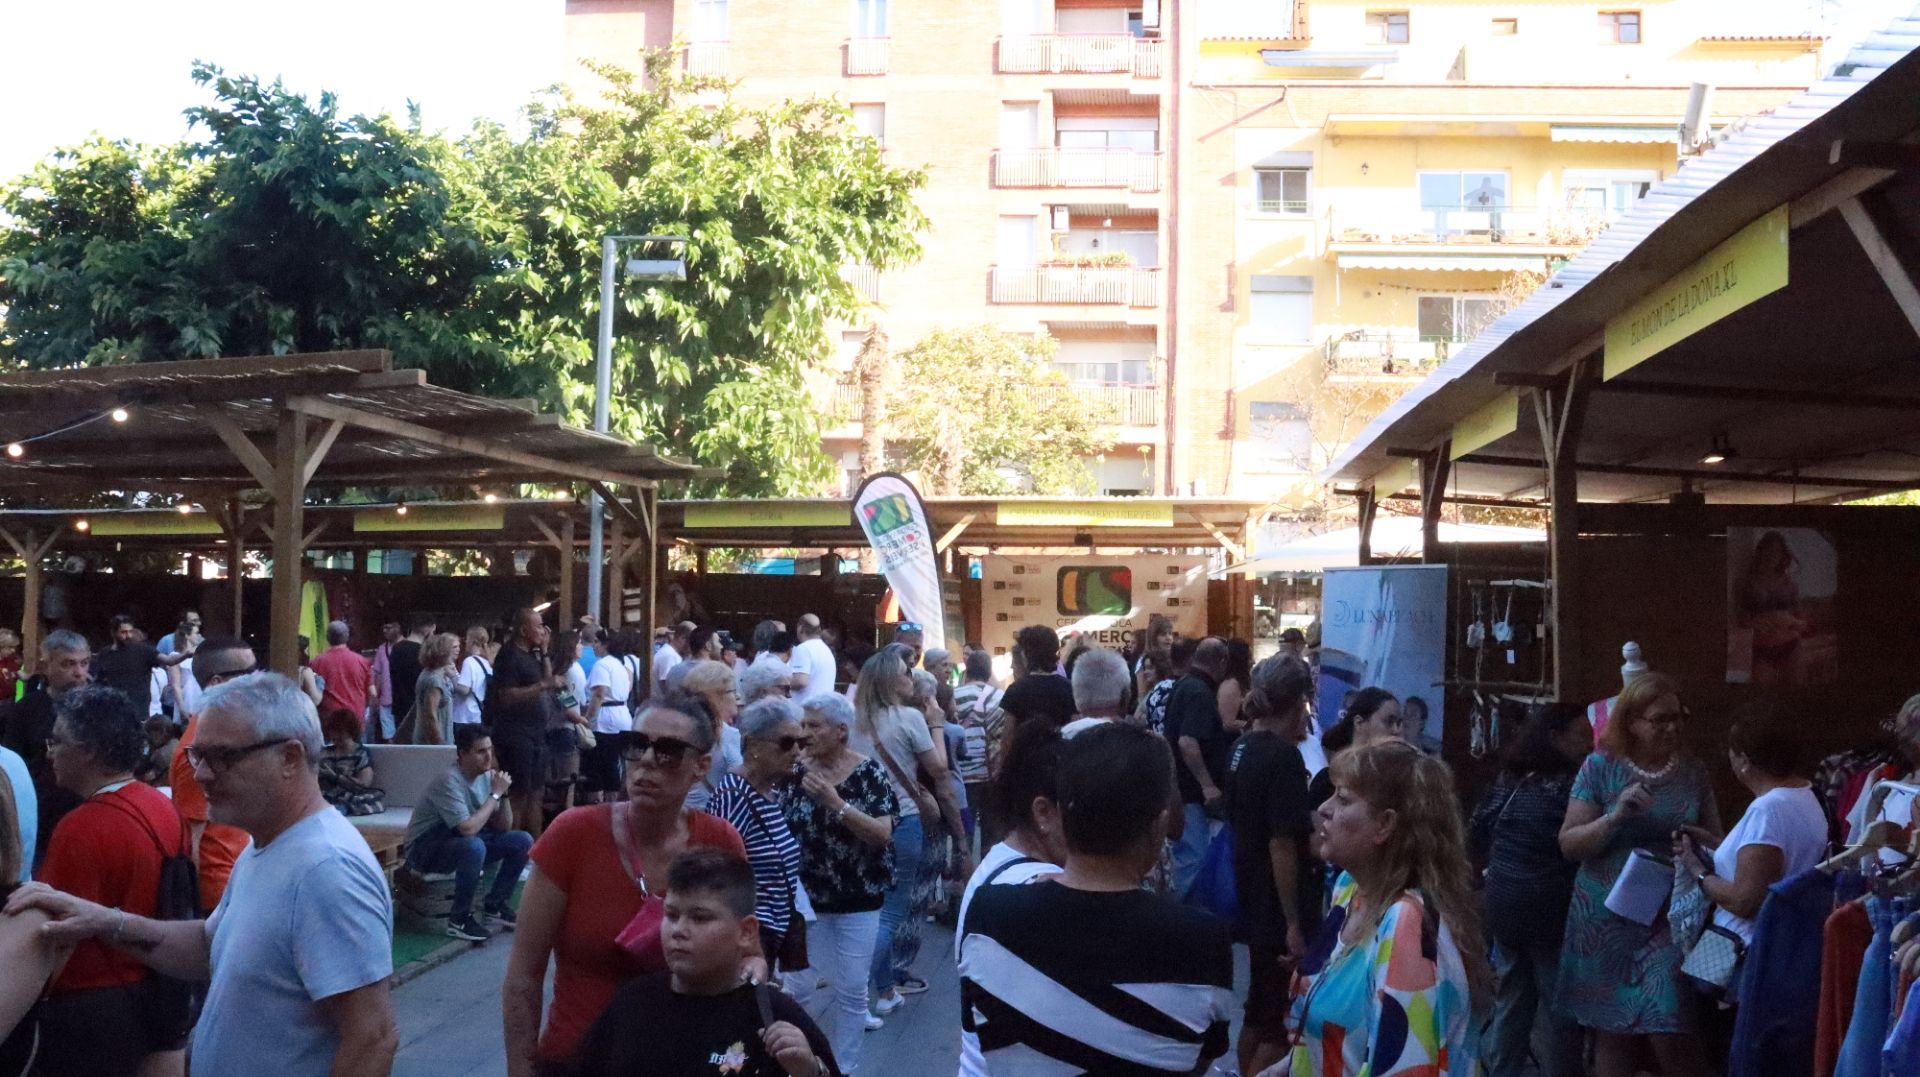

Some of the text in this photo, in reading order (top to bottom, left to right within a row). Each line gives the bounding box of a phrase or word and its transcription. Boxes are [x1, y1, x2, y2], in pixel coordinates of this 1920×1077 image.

[1678, 288, 1691, 318] LA
[1690, 270, 1722, 312] DONA
[1722, 259, 1738, 293] XL
[1056, 618, 1133, 628] CEROLA
